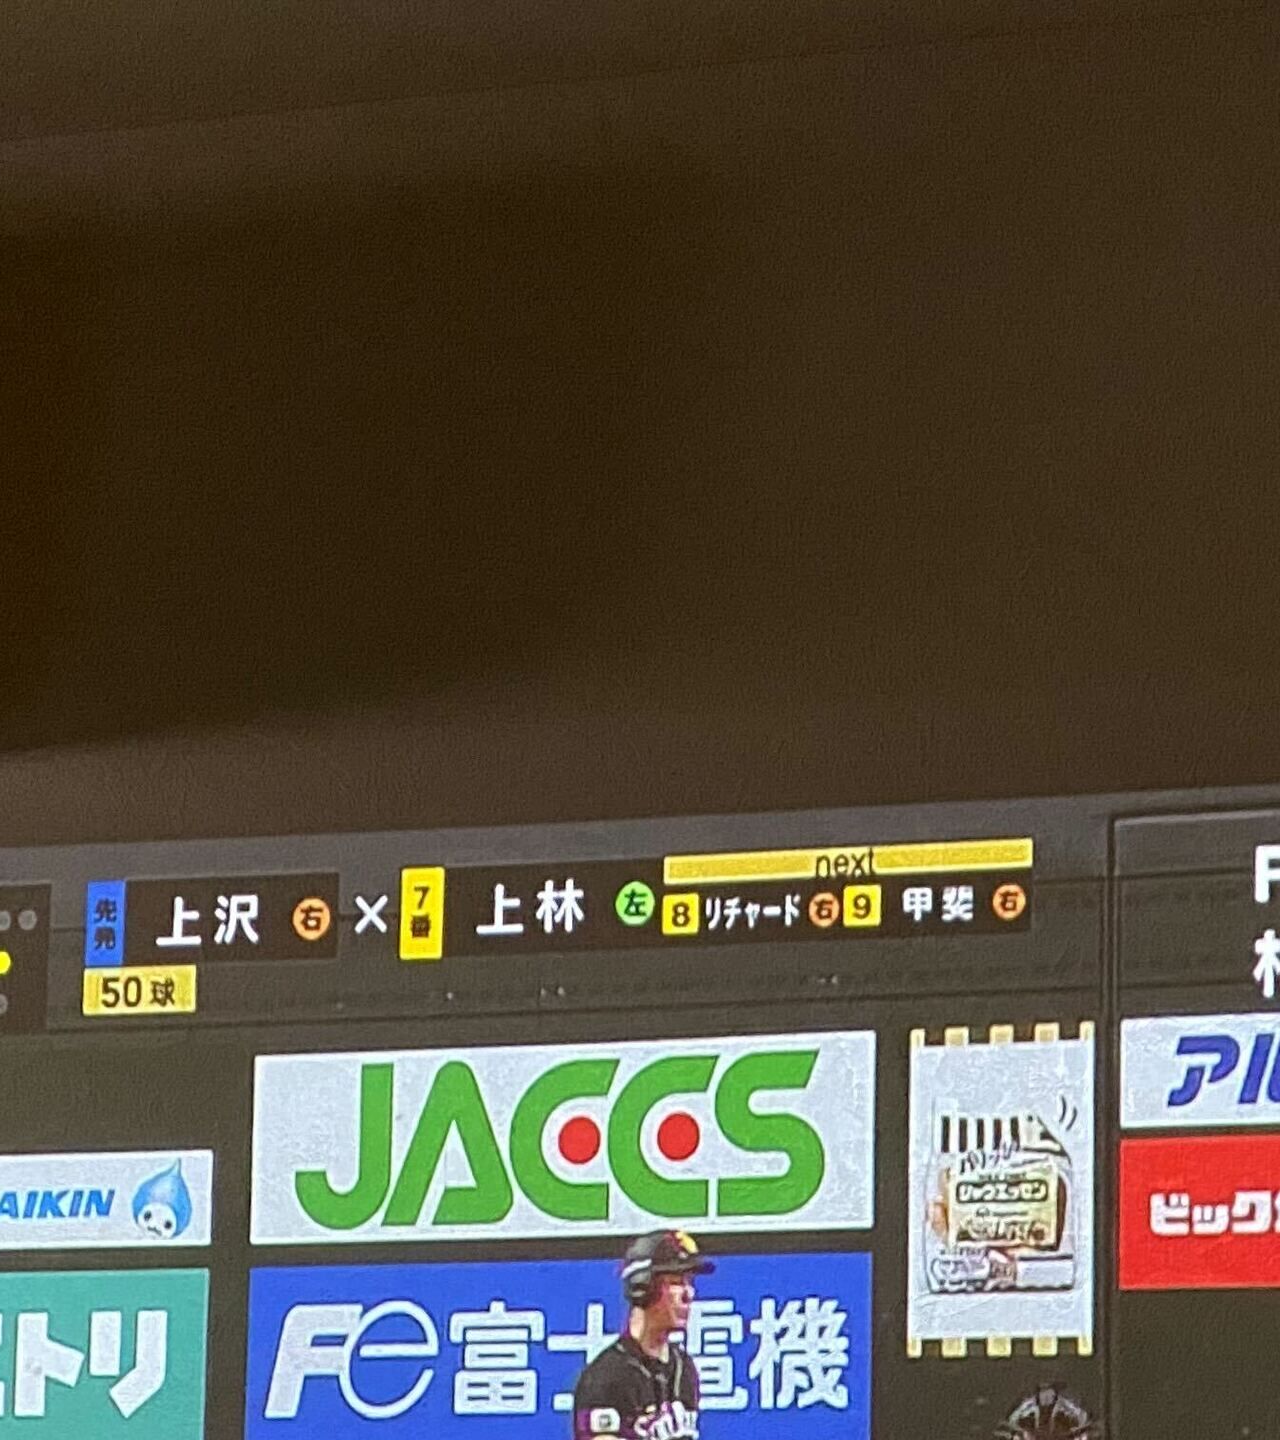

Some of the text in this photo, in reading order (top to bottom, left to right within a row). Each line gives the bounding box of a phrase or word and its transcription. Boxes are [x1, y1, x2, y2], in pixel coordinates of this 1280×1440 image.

[815, 848, 875, 878] next
[156, 894, 259, 947] 上沢
[476, 878, 650, 934] 上林 左
[671, 903, 690, 927] 8
[705, 894, 801, 930] リチャード
[853, 894, 873, 920] 9
[295, 1049, 826, 1230] JACCS
